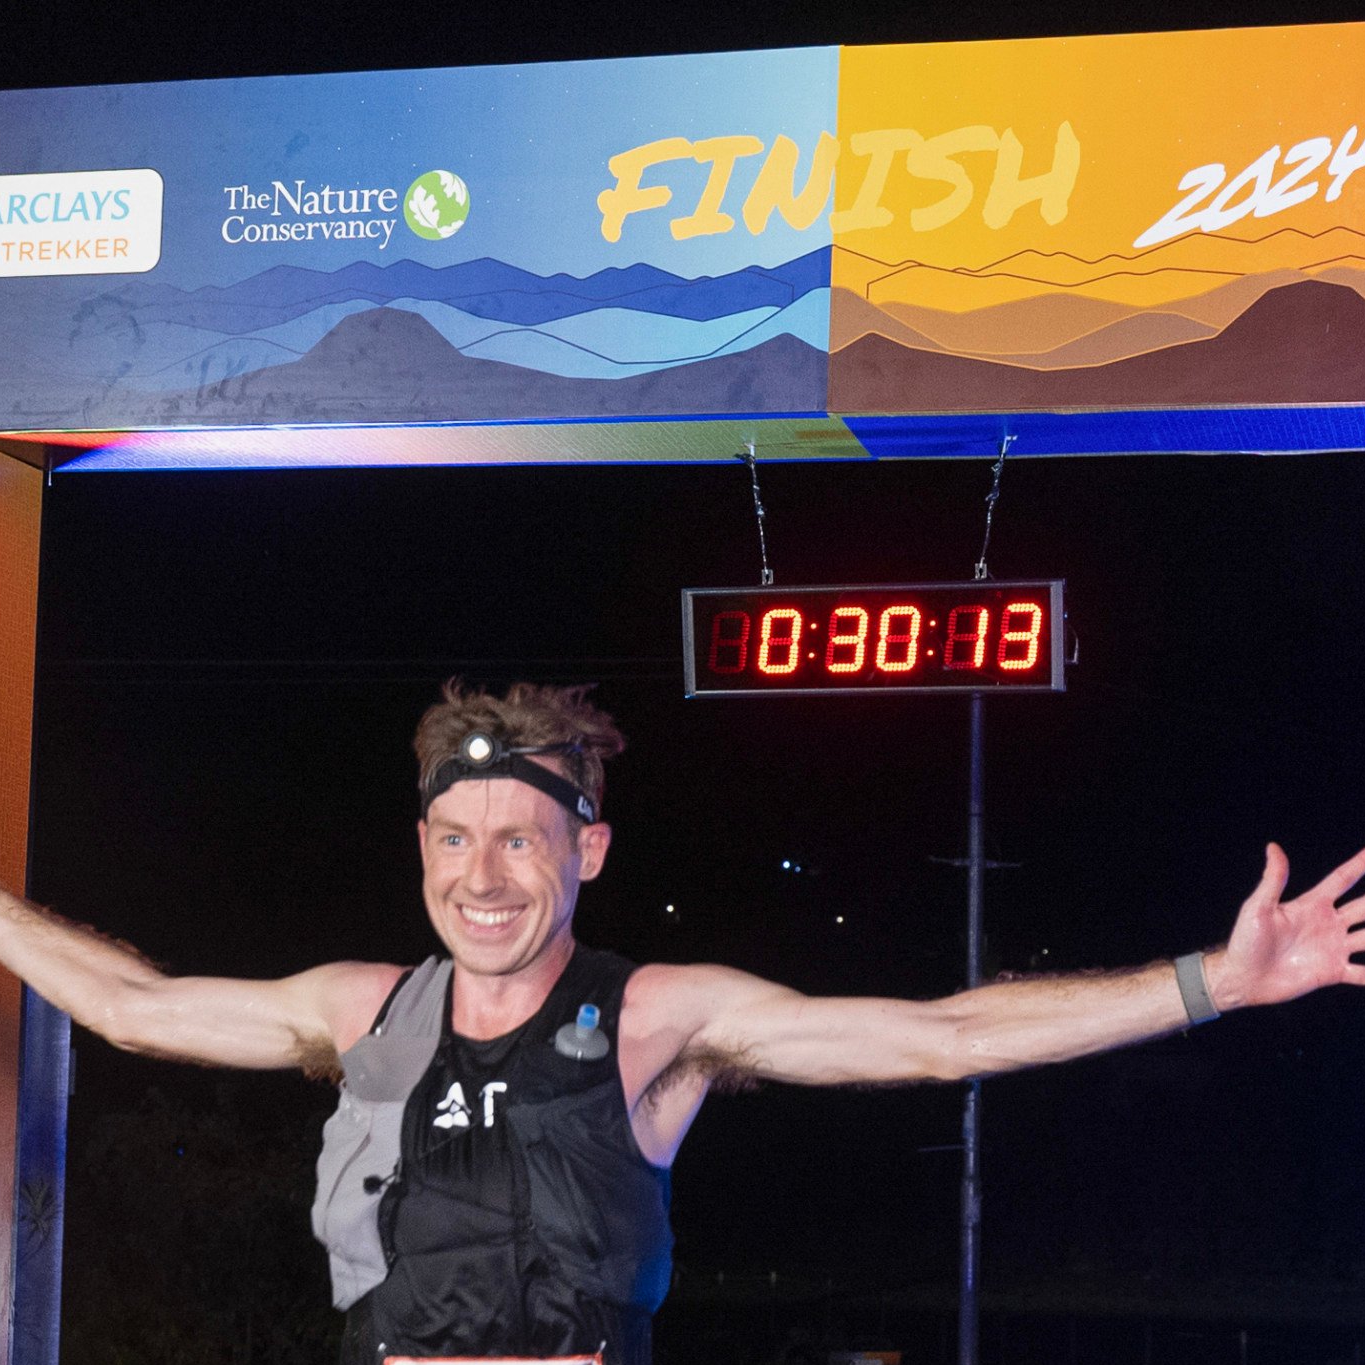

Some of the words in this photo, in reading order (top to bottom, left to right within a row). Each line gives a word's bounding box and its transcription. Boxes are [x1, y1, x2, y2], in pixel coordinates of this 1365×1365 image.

[224, 185, 272, 210] The
[271, 180, 398, 216] Nature
[596, 120, 1081, 243] FINISH
[221, 215, 397, 250] Conservancy
[758, 602, 1042, 675] 0:30:13
